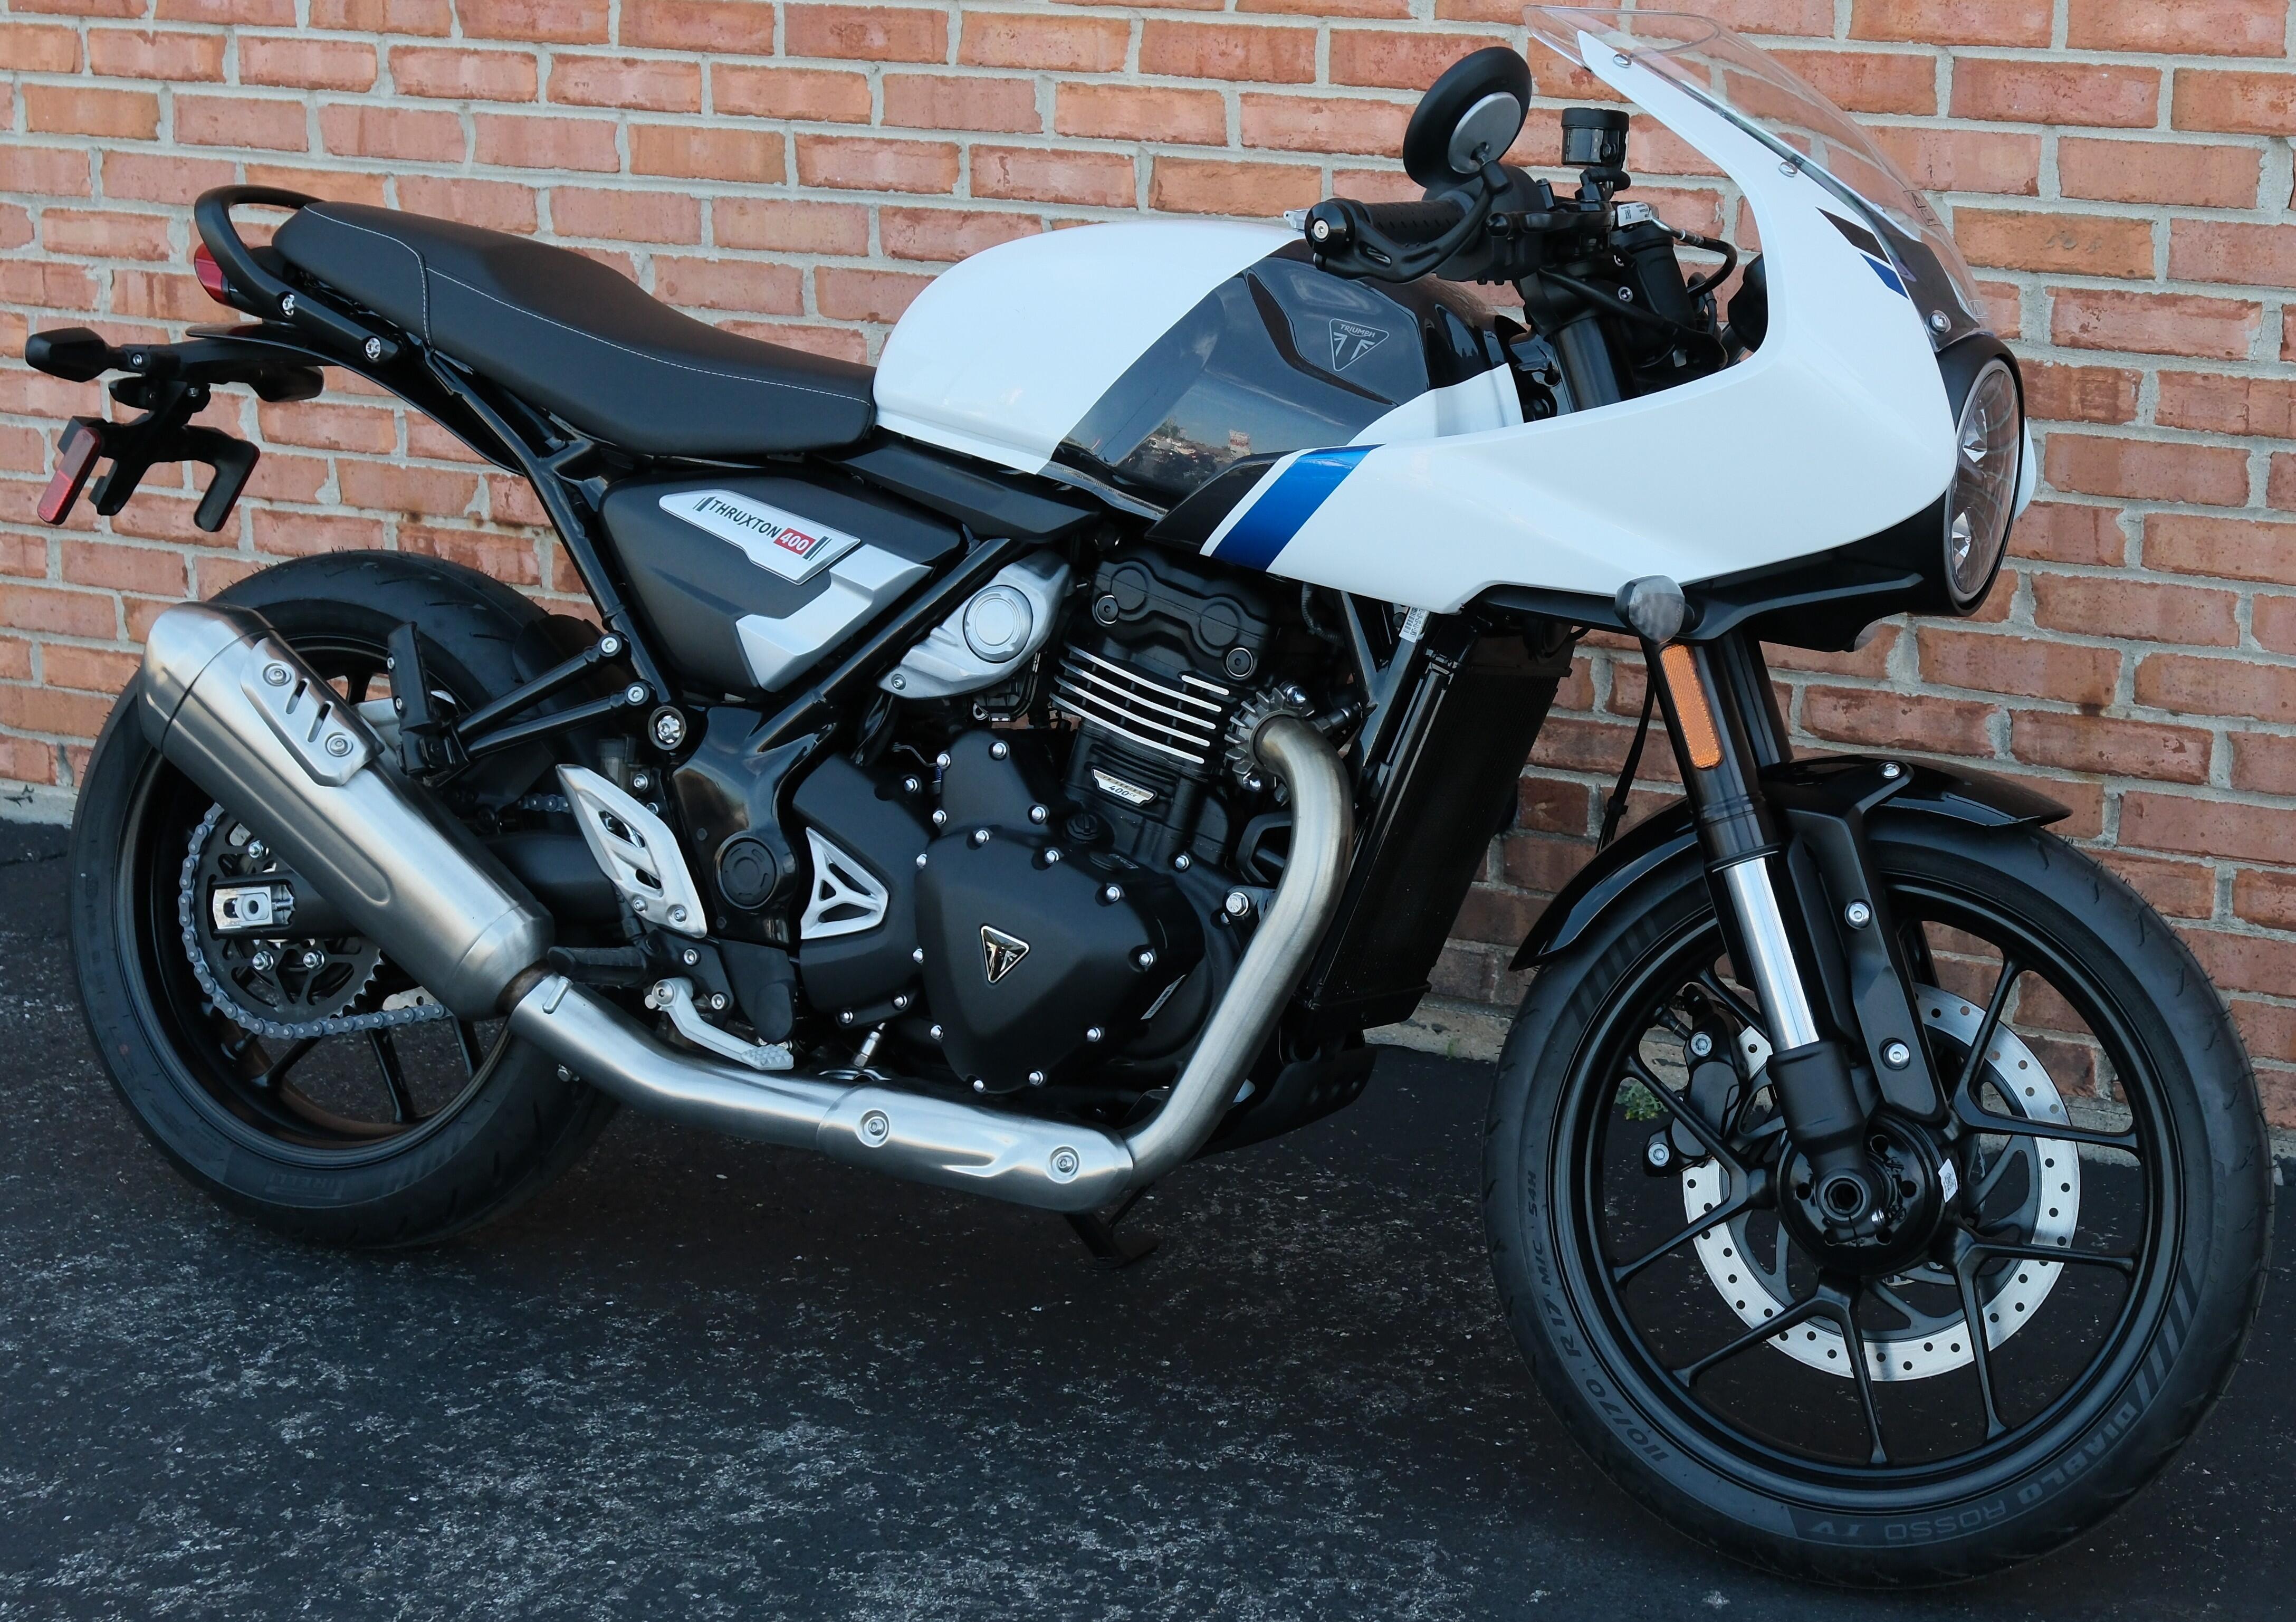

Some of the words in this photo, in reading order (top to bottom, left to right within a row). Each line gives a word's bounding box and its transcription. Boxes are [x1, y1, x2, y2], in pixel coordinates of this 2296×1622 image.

[1341, 323, 1376, 338] TRIUMPH
[709, 499, 782, 538] THRUXTON
[779, 532, 810, 551] 400
[1527, 1170, 1538, 1217] 54H
[1543, 1296, 1566, 1327] 17
[1560, 1334, 1582, 1358] R
[1585, 1379, 1670, 1462] 110/70
[2017, 1401, 2139, 1504] DIABLO
[1884, 1499, 2006, 1540] ROSSO
